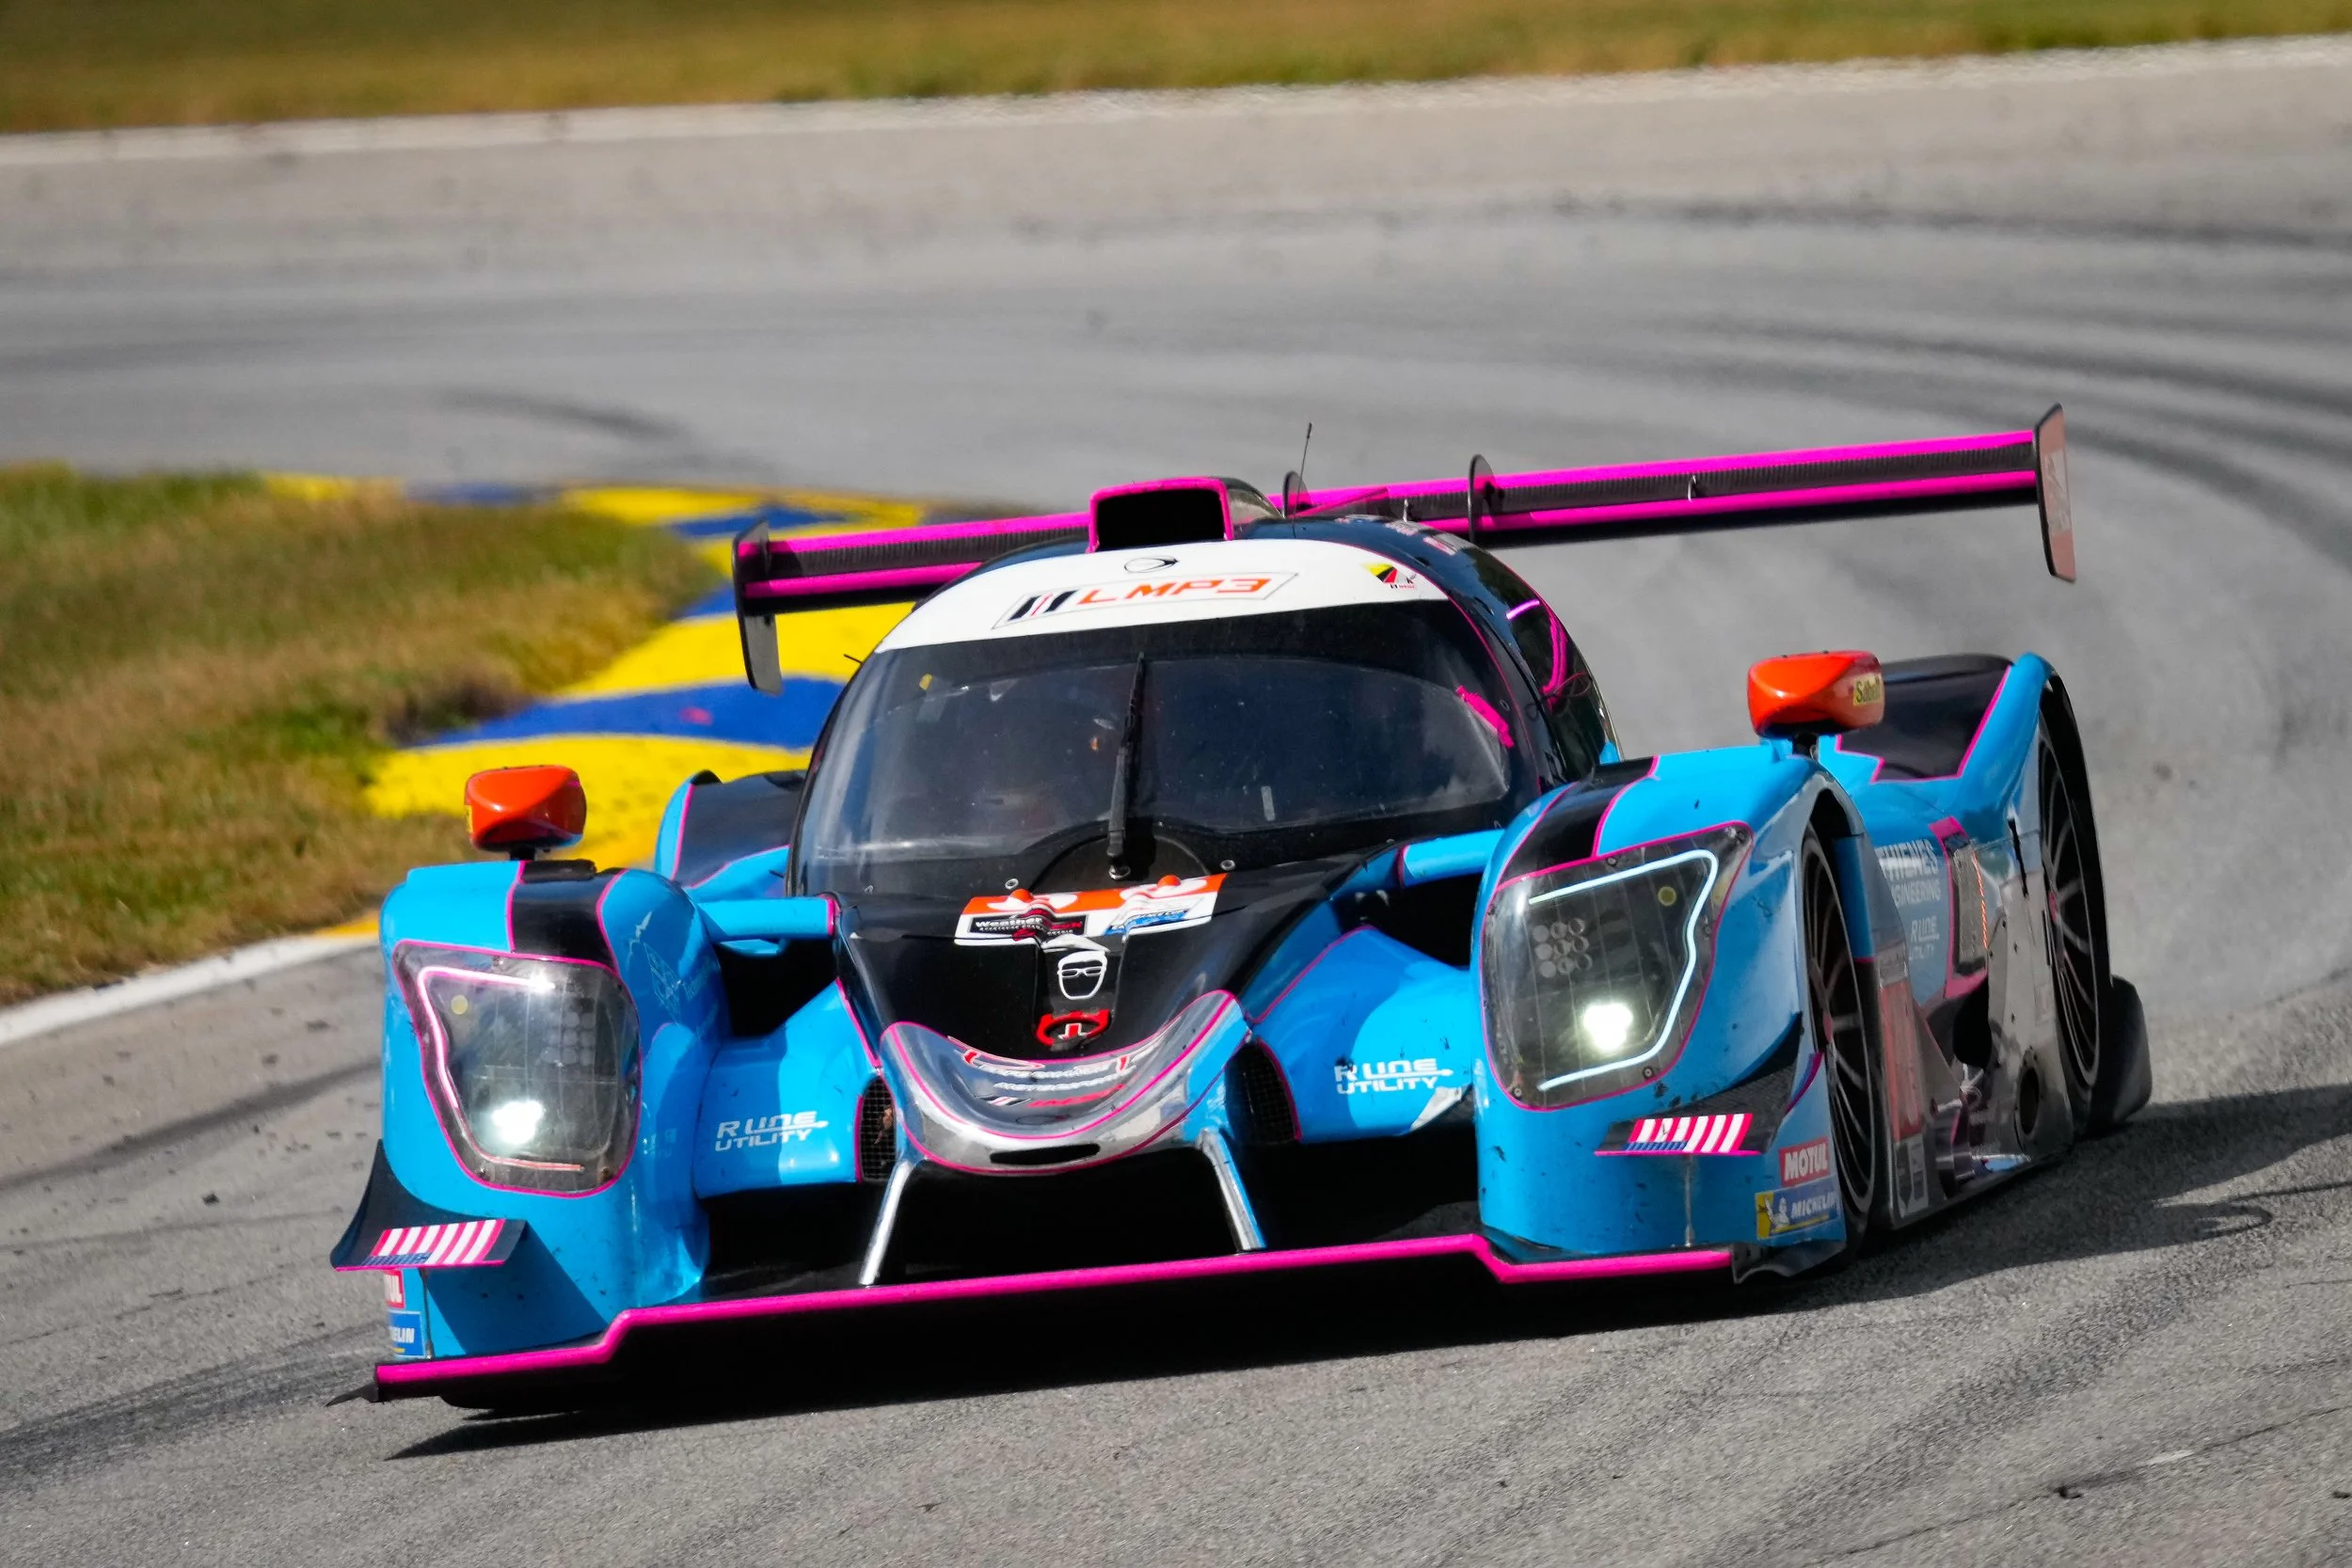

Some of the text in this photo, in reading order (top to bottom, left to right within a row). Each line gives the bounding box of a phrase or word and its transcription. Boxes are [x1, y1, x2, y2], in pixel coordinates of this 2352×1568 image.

[1076, 578, 1272, 606] LMP3
[1336, 1076, 1438, 1095] UTILITY
[715, 1129, 813, 1151] UTILITY
[1784, 1143, 1828, 1181] MOTUL
